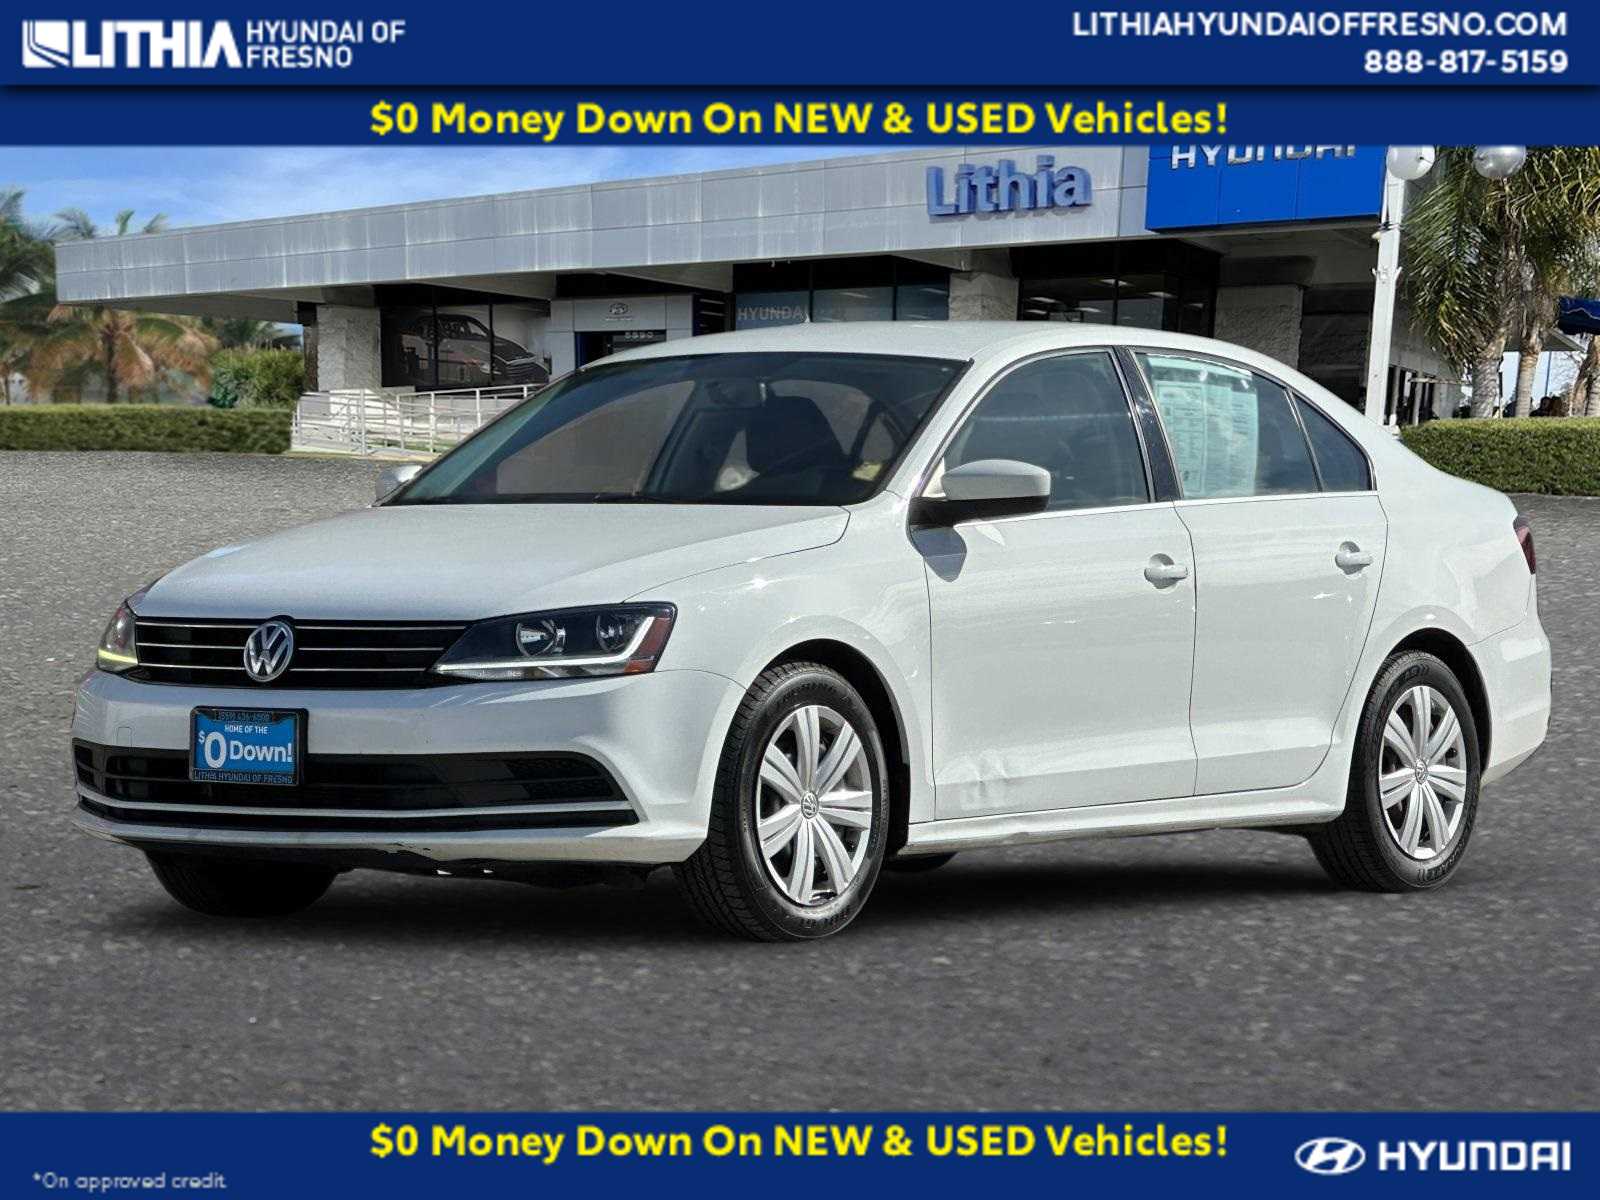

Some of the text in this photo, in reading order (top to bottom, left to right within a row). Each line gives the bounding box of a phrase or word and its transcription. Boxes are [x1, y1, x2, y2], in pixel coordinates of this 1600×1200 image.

[926, 154, 1093, 216] Lithia
[224, 724, 268, 735] HOME OF THE
[229, 740, 293, 763] Down!
